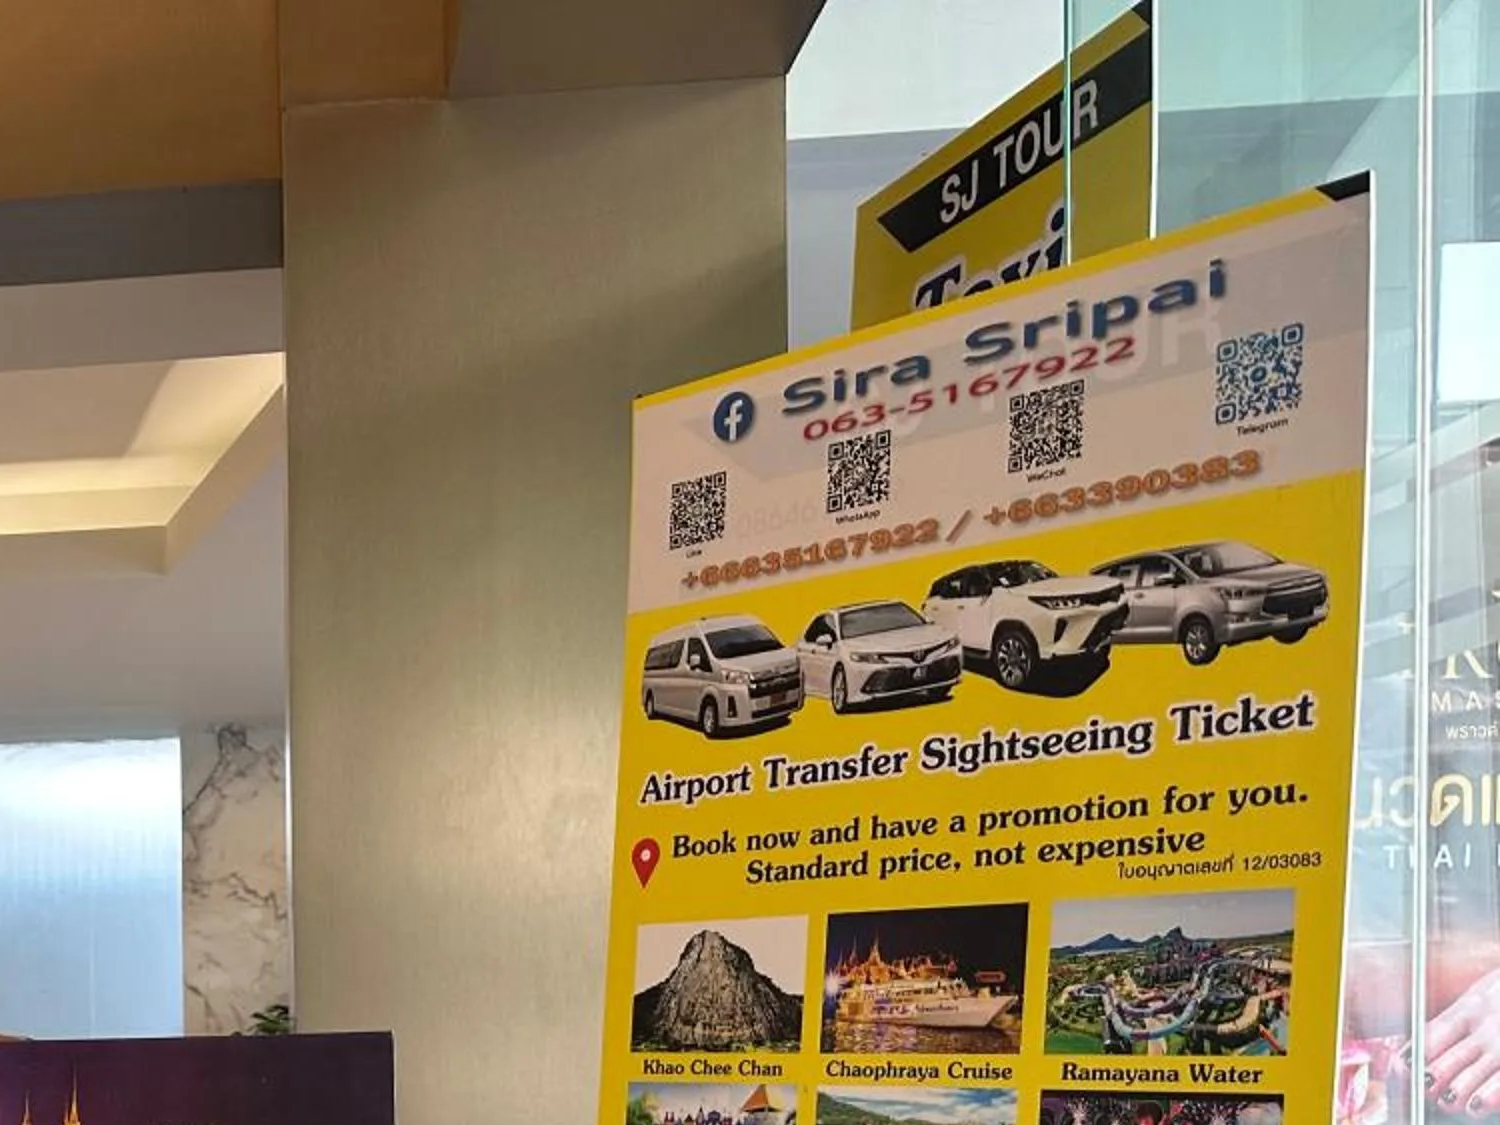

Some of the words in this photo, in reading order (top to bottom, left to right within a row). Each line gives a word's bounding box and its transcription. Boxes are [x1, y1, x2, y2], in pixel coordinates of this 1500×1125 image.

[940, 159, 979, 224] SJ
[993, 79, 1098, 190] TOUR
[781, 353, 931, 415] Sira
[965, 258, 1227, 366] Sripai
[803, 336, 1136, 441] 063-5167922
[1236, 417, 1289, 438] Telegram
[640, 763, 751, 804] Airport
[763, 745, 908, 788] Transfer
[920, 718, 1153, 773] Sightseeing
[1170, 694, 1315, 741] Ticket
[673, 830, 736, 858] Book
[746, 831, 800, 851] now
[810, 816, 860, 846] and
[871, 814, 937, 840] have
[949, 815, 966, 834] a
[978, 794, 1148, 836] promotion
[1163, 785, 1215, 815] for
[1228, 783, 1309, 815] you.
[746, 850, 868, 885] Standard
[879, 848, 962, 880] price,
[975, 842, 1025, 867] not
[1037, 827, 1206, 866] expensive
[1243, 850, 1322, 872] 12/03083
[643, 1059, 684, 1076] Khao
[690, 1059, 732, 1076] Chee
[738, 1059, 783, 1077] Chan
[825, 1060, 940, 1080] Chaophraya
[947, 1062, 1013, 1080] Cruise
[1061, 1063, 1180, 1086] Ramayana
[1188, 1064, 1264, 1084] Water
